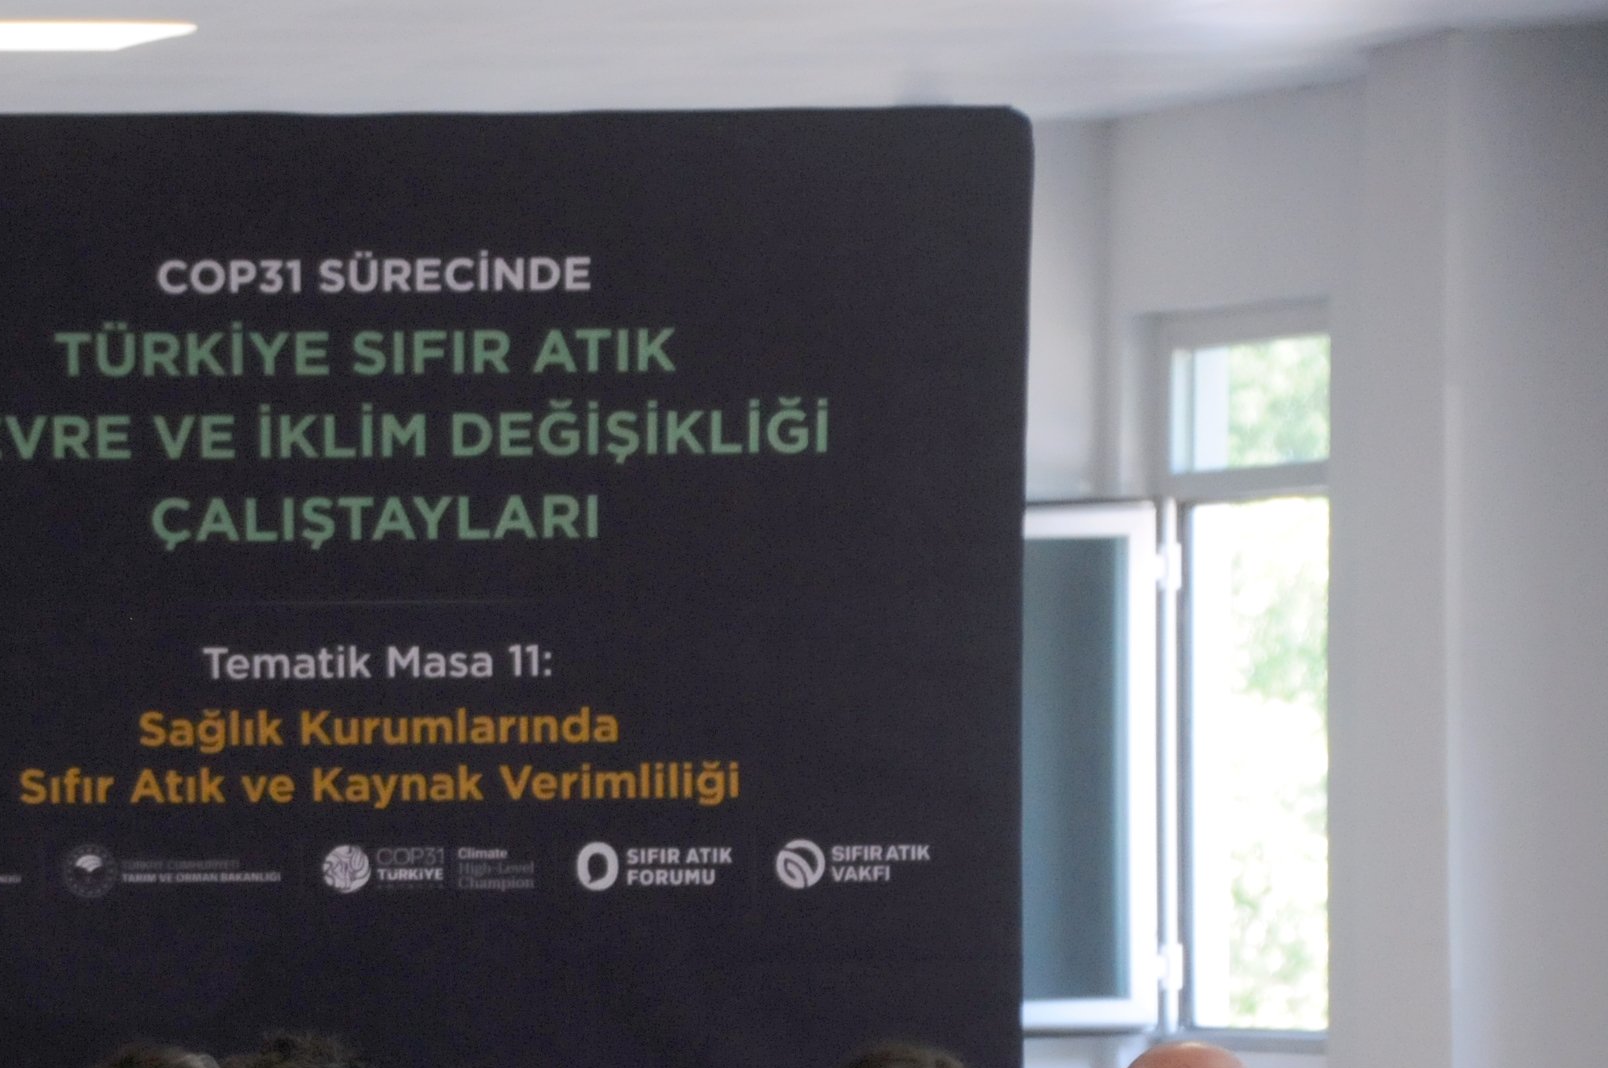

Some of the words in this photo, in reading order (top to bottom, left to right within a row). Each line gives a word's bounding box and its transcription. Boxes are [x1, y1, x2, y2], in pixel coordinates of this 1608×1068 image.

[158, 260, 302, 296] COP31
[320, 250, 592, 294] SÜRECİNDE
[56, 322, 330, 378] TÜRKİYE
[354, 331, 511, 377] SIFIR
[534, 329, 677, 375] ATIK
[155, 415, 236, 461] VE
[261, 404, 428, 461] İKLİM
[453, 397, 830, 467] DEĞİŞİKLİĞİ
[152, 495, 600, 552] ÇALIŞTAYLARI
[203, 646, 372, 681] Tematik
[388, 646, 494, 680] Masa
[509, 645, 553, 679] 11:
[139, 709, 284, 753] Sağlık
[302, 708, 620, 748] Kurumlarında
[20, 767, 115, 806] Sıfır
[131, 767, 226, 806] Atık
[242, 775, 296, 805] ve
[313, 766, 484, 811] Kaynak
[500, 762, 742, 808] Verimliliği
[376, 846, 445, 866] COP31
[457, 846, 508, 860] Climate
[626, 848, 681, 866] SIFIR
[686, 847, 734, 866] ATIK
[831, 845, 884, 863] SIFIR
[886, 844, 931, 862] ATIK
[122, 872, 157, 883] TARIM
[175, 872, 219, 883] ORMAN
[458, 859, 535, 877] High-Level
[832, 866, 892, 883] VAKFI
[457, 875, 535, 892] Champion
[627, 869, 717, 887] FORUMU
